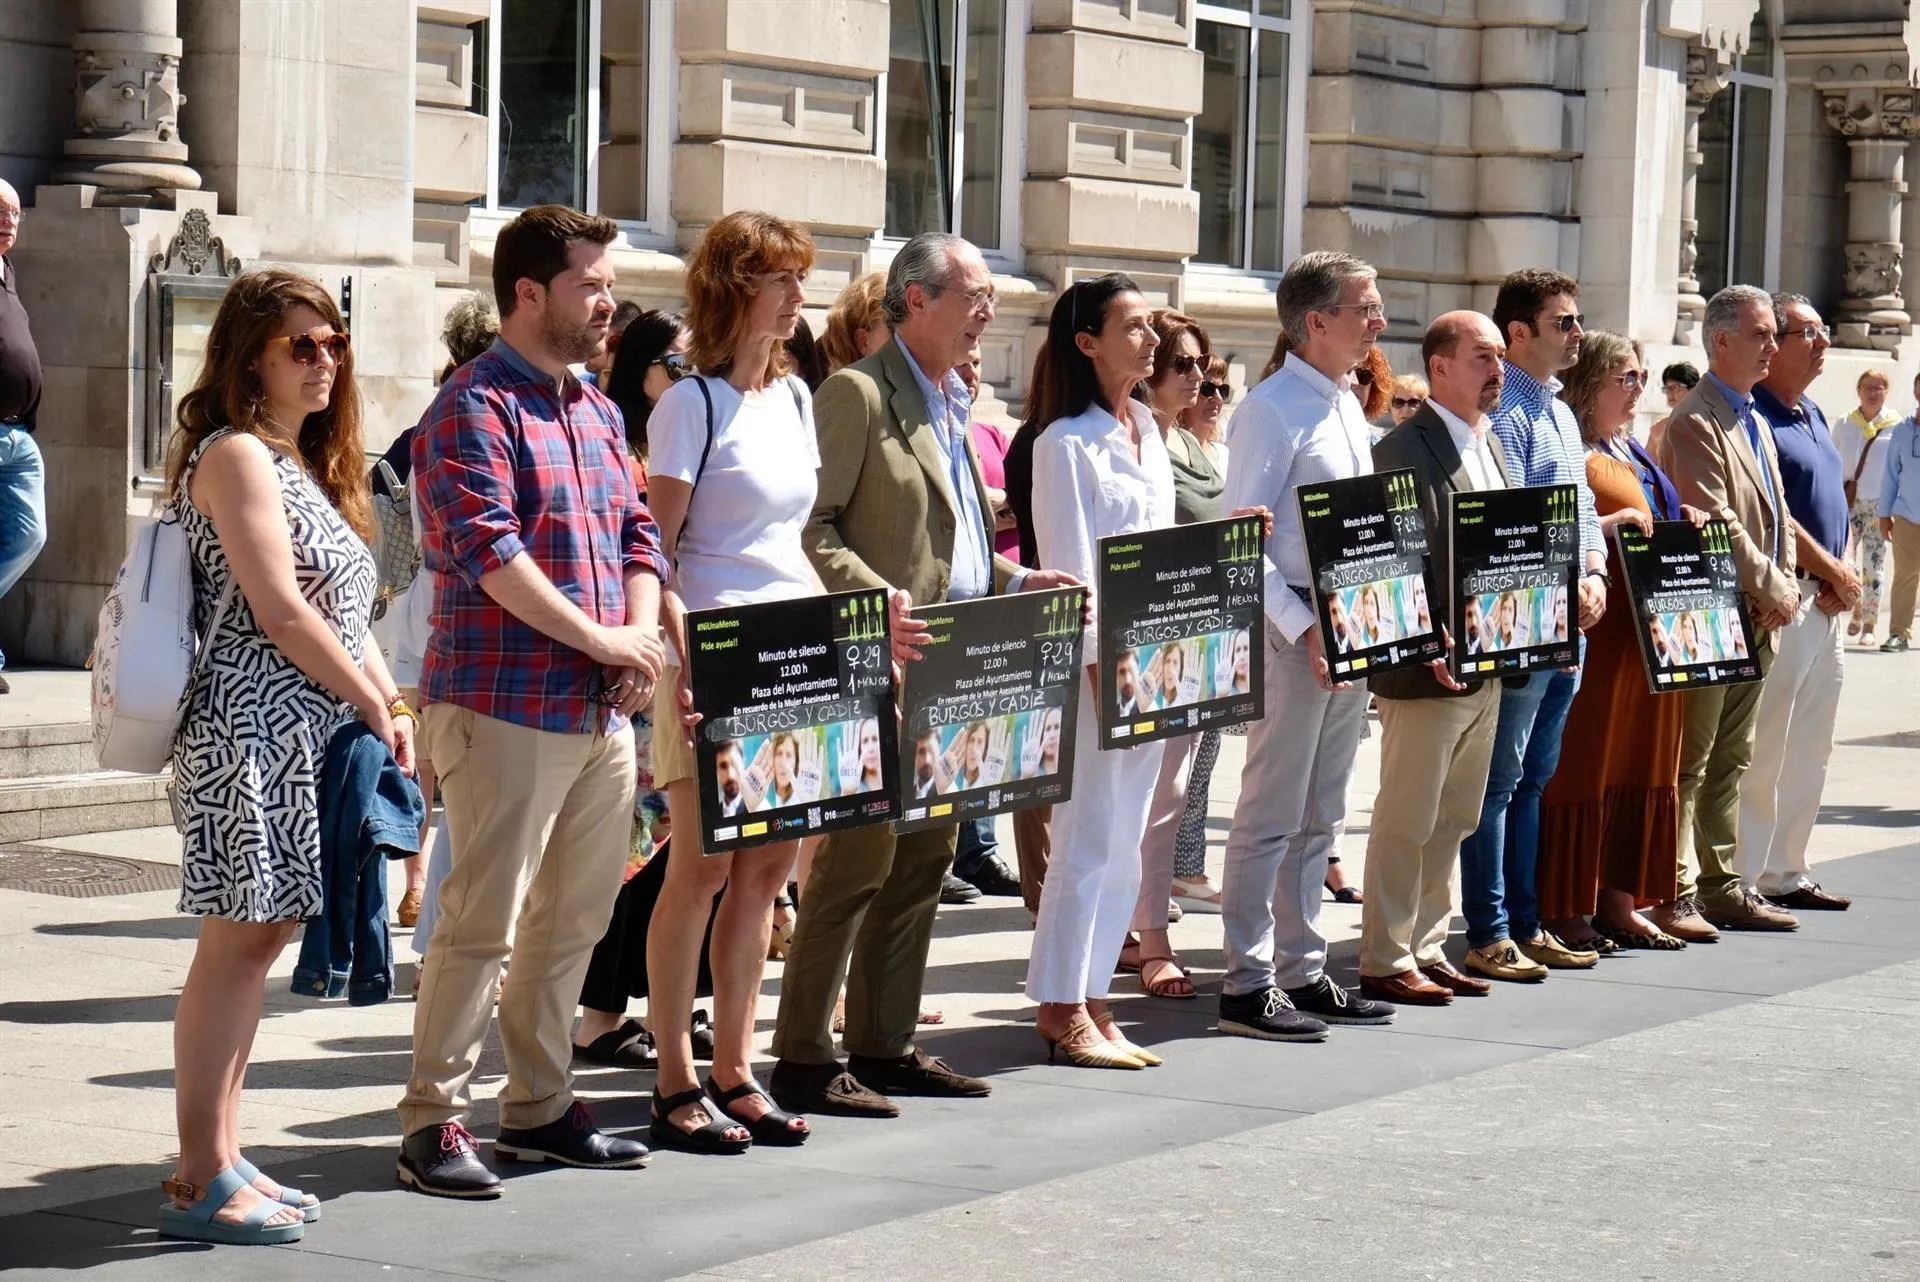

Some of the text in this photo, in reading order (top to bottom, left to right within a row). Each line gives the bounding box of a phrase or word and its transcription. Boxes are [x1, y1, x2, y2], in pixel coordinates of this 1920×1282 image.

[1343, 513, 1385, 528] Minuto de silencio
[1404, 515, 1416, 533] 29
[1358, 529, 1372, 540] 12.00
[1495, 524, 1538, 536] Minuto de silencio
[1558, 527, 1569, 543] 29
[1343, 541, 1395, 558] Plaza del Ayuntamiento
[1508, 539, 1521, 549] 12.00
[1490, 555, 1502, 564] Plaza
[1511, 551, 1543, 563] Ayuntamiento
[1111, 563, 1121, 571] Pide
[1156, 565, 1211, 582] Minuto de silencio
[1241, 566, 1256, 586] 29
[1328, 562, 1409, 589] BURGOS Y CADIZ
[1173, 582, 1195, 594] 12.00 h
[1470, 572, 1559, 593] BURGOS Y CADIZ
[1149, 595, 1219, 613] Plaza del Ayuntamiento
[1232, 595, 1260, 607] MENOR
[1647, 596, 1726, 613] BURGOS Y CADIZ
[697, 620, 740, 632] #NiUnaMenos
[1134, 620, 1139, 628] En
[1140, 617, 1161, 627] recuerdo
[1162, 615, 1168, 623] de
[1169, 614, 1174, 622] la
[1175, 612, 1189, 621] Mujer
[1189, 608, 1213, 618] Asesinada
[1125, 616, 1234, 647] BURGOS Y CADIZ
[701, 638, 738, 651] Pide ayuda!!
[759, 644, 827, 663] Minuto de silencio
[966, 639, 1027, 657] Minuto de silencio
[863, 645, 880, 668] 29
[1052, 643, 1073, 665] 29
[780, 663, 808, 677] 12.00 h
[983, 657, 1008, 670] 12.00 h
[848, 674, 889, 695] 1 MENOR
[956, 671, 1032, 690] Plaza del Ayuntamiento
[1040, 669, 1045, 687] 1
[752, 678, 838, 699] Plaza del Ayuntamiento
[938, 697, 944, 705] En
[945, 693, 968, 704] recuerdo
[969, 692, 976, 700] de
[977, 691, 982, 699] la
[983, 689, 998, 698] Mujer
[999, 684, 1024, 695] Asesinada
[734, 707, 741, 716] En
[742, 703, 768, 714] recuerdo
[769, 701, 777, 710] de
[778, 700, 783, 709] la
[784, 698, 802, 708] Mujer
[803, 693, 831, 705] Asesinada
[929, 690, 1046, 726] BURGOS Y CADIZ
[726, 709, 798, 736] BURGOS
[806, 706, 813, 724] Y
[1003, 793, 1014, 802] 016
[824, 810, 836, 821] 016
